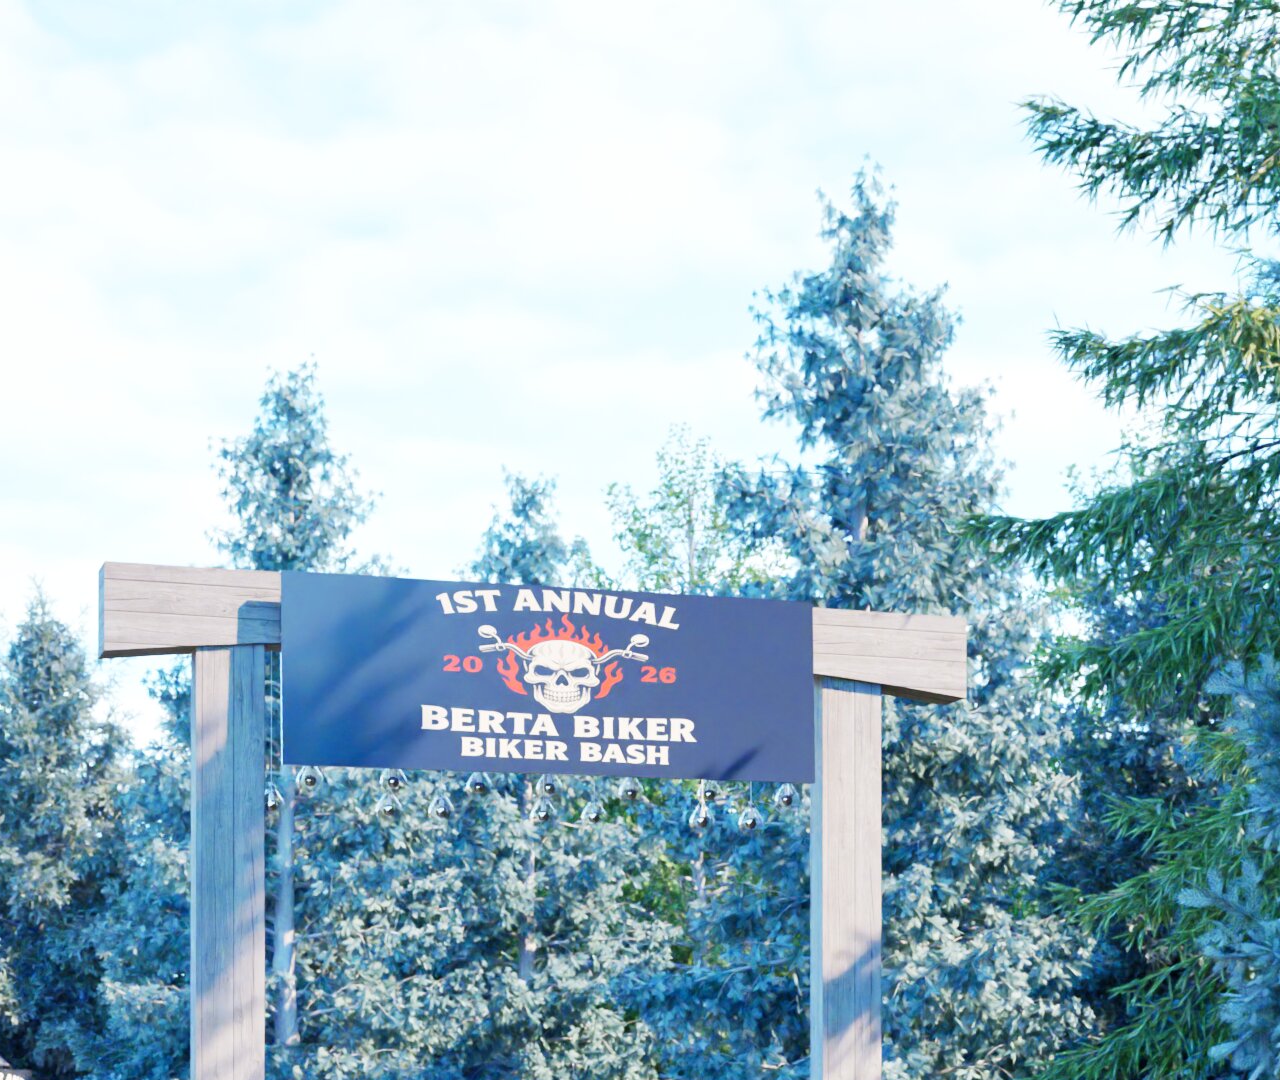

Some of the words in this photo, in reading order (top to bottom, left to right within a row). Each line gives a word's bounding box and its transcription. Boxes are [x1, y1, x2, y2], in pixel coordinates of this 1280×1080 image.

[436, 589, 502, 616] 1ST
[513, 588, 681, 631] ANNUAL
[442, 654, 483, 674] 20
[640, 665, 677, 685] 26
[421, 704, 560, 738] BERTA
[573, 714, 697, 744] BIKER
[460, 735, 570, 761] BIKER
[580, 741, 671, 766] BASH
